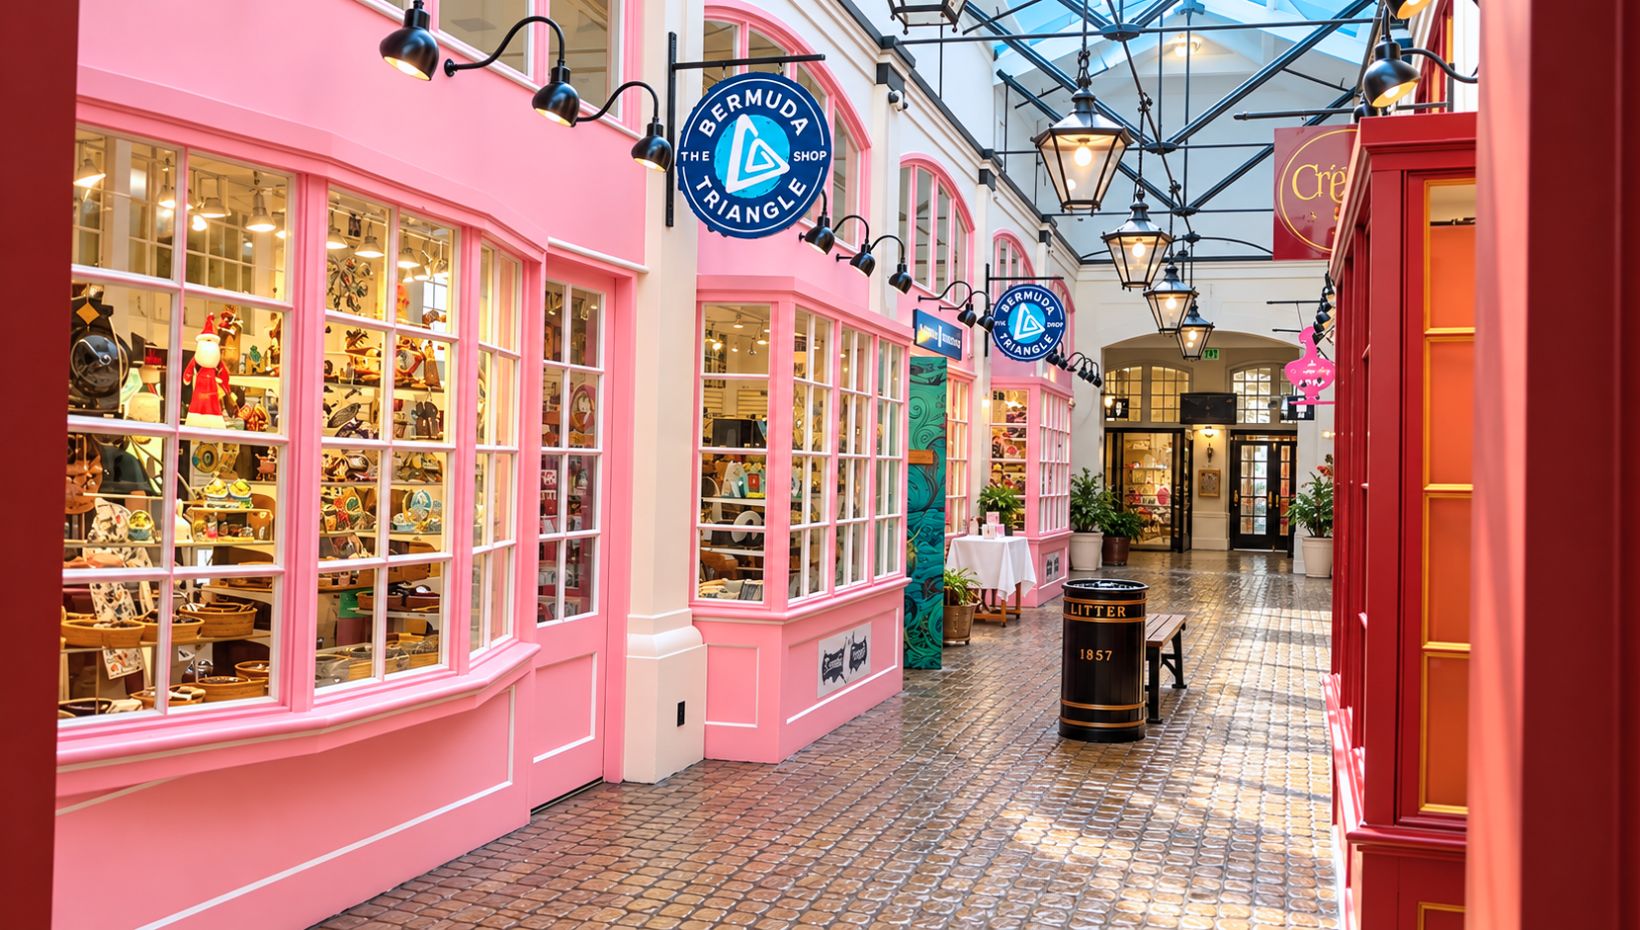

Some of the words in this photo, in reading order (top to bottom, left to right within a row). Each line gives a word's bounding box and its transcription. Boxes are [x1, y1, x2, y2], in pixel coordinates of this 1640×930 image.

[699, 89, 808, 138] BERMUDA
[681, 151, 710, 161] THE
[793, 151, 827, 161] SHOP
[696, 175, 807, 223] TRIANGLE
[1001, 291, 1054, 316] BERMUDA
[1000, 333, 1053, 355] TRIANGLE
[1071, 603, 1126, 617] LITTER
[1080, 649, 1112, 661] 1857
